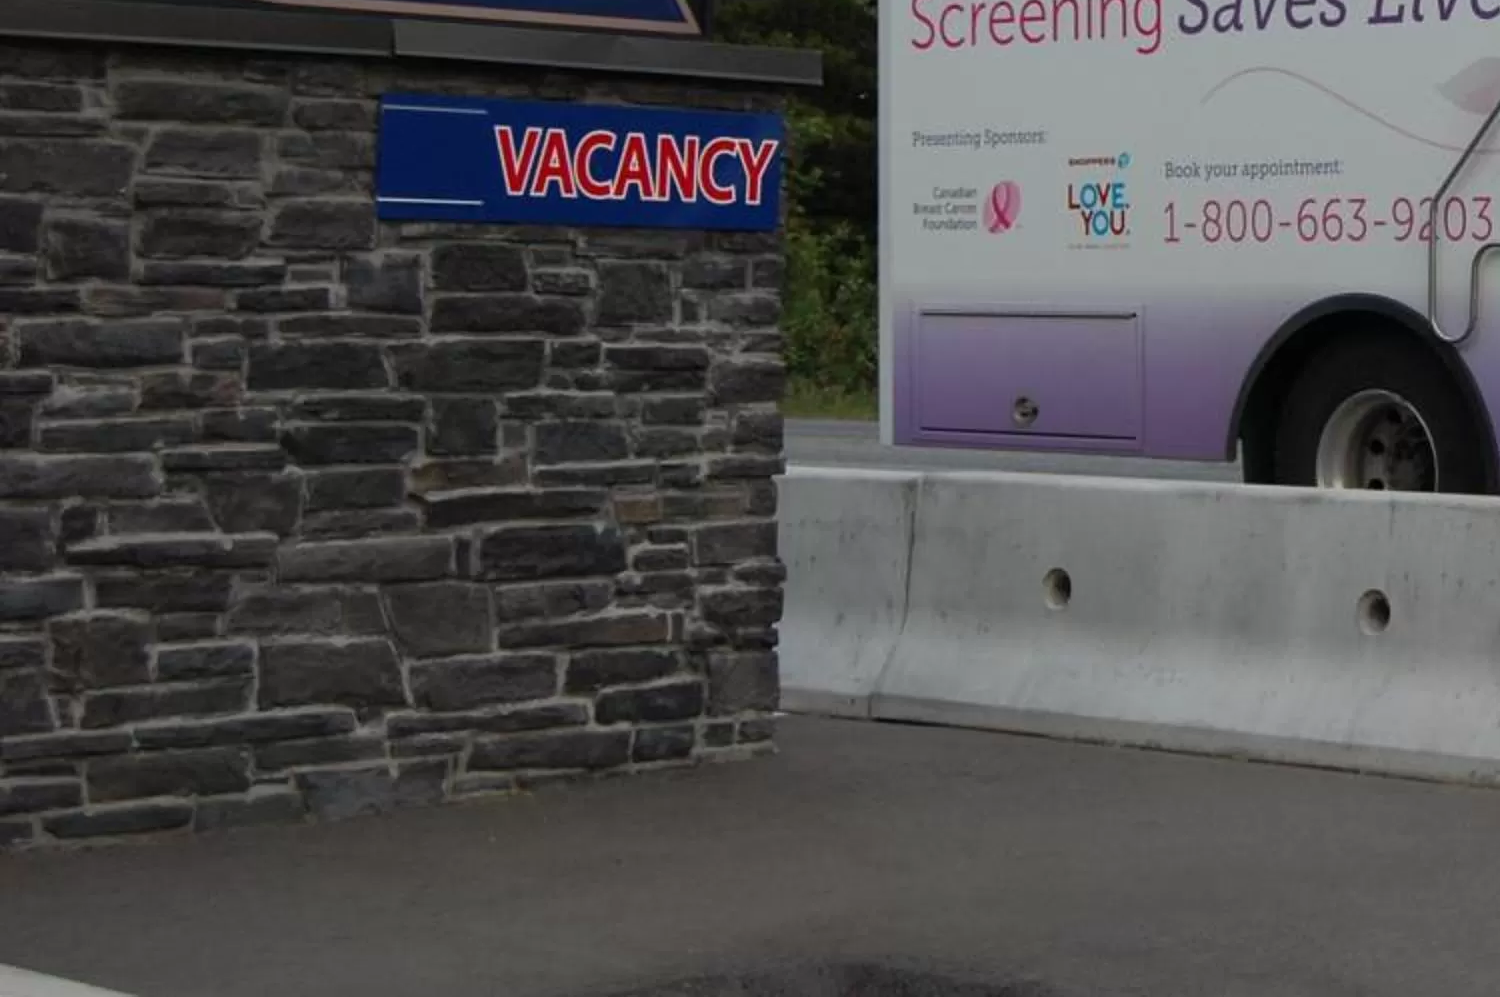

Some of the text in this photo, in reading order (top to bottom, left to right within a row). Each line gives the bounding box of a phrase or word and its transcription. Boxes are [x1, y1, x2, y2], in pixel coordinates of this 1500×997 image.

[911, 130, 981, 151] Presenting
[494, 125, 779, 205] VACANCY
[1164, 160, 1201, 178] Book
[1204, 162, 1238, 181] your
[1163, 195, 1493, 244] 1-800-663-9203
